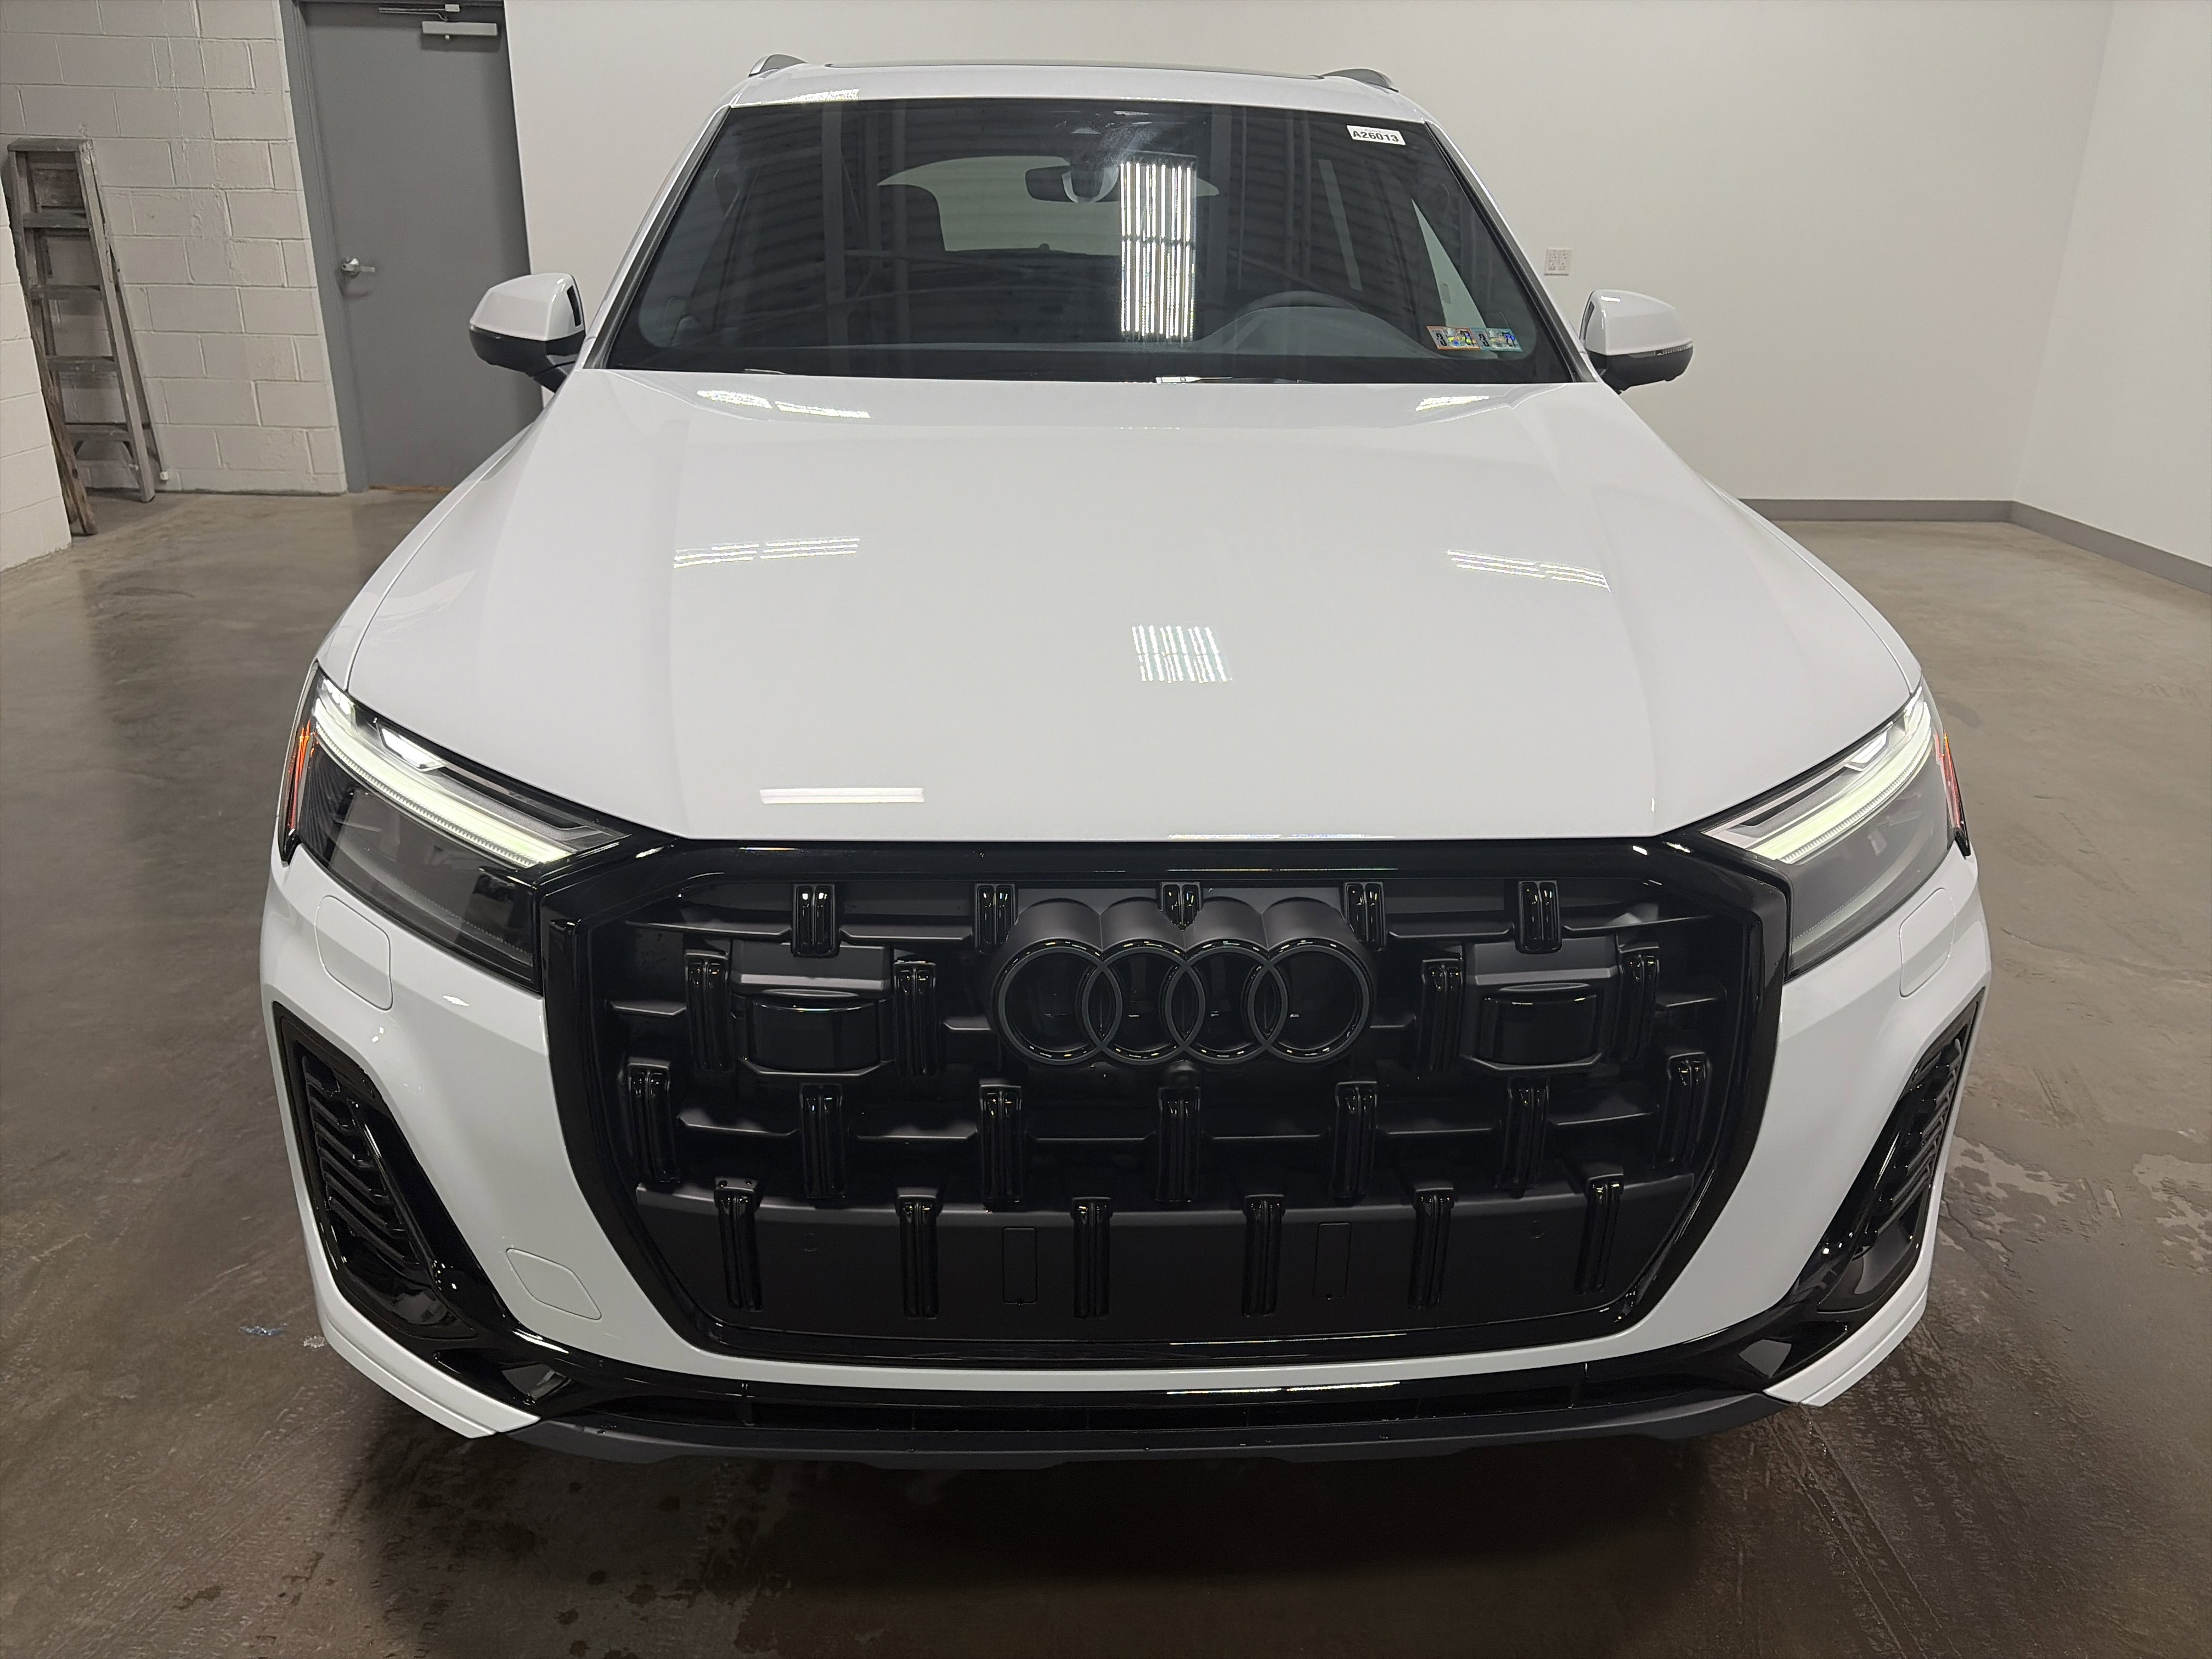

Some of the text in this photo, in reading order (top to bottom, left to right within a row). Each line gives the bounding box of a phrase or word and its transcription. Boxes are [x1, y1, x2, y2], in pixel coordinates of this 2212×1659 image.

[1353, 131, 1399, 142] A26013
[1436, 333, 1448, 346] 3
[1479, 334, 1490, 347] 3
